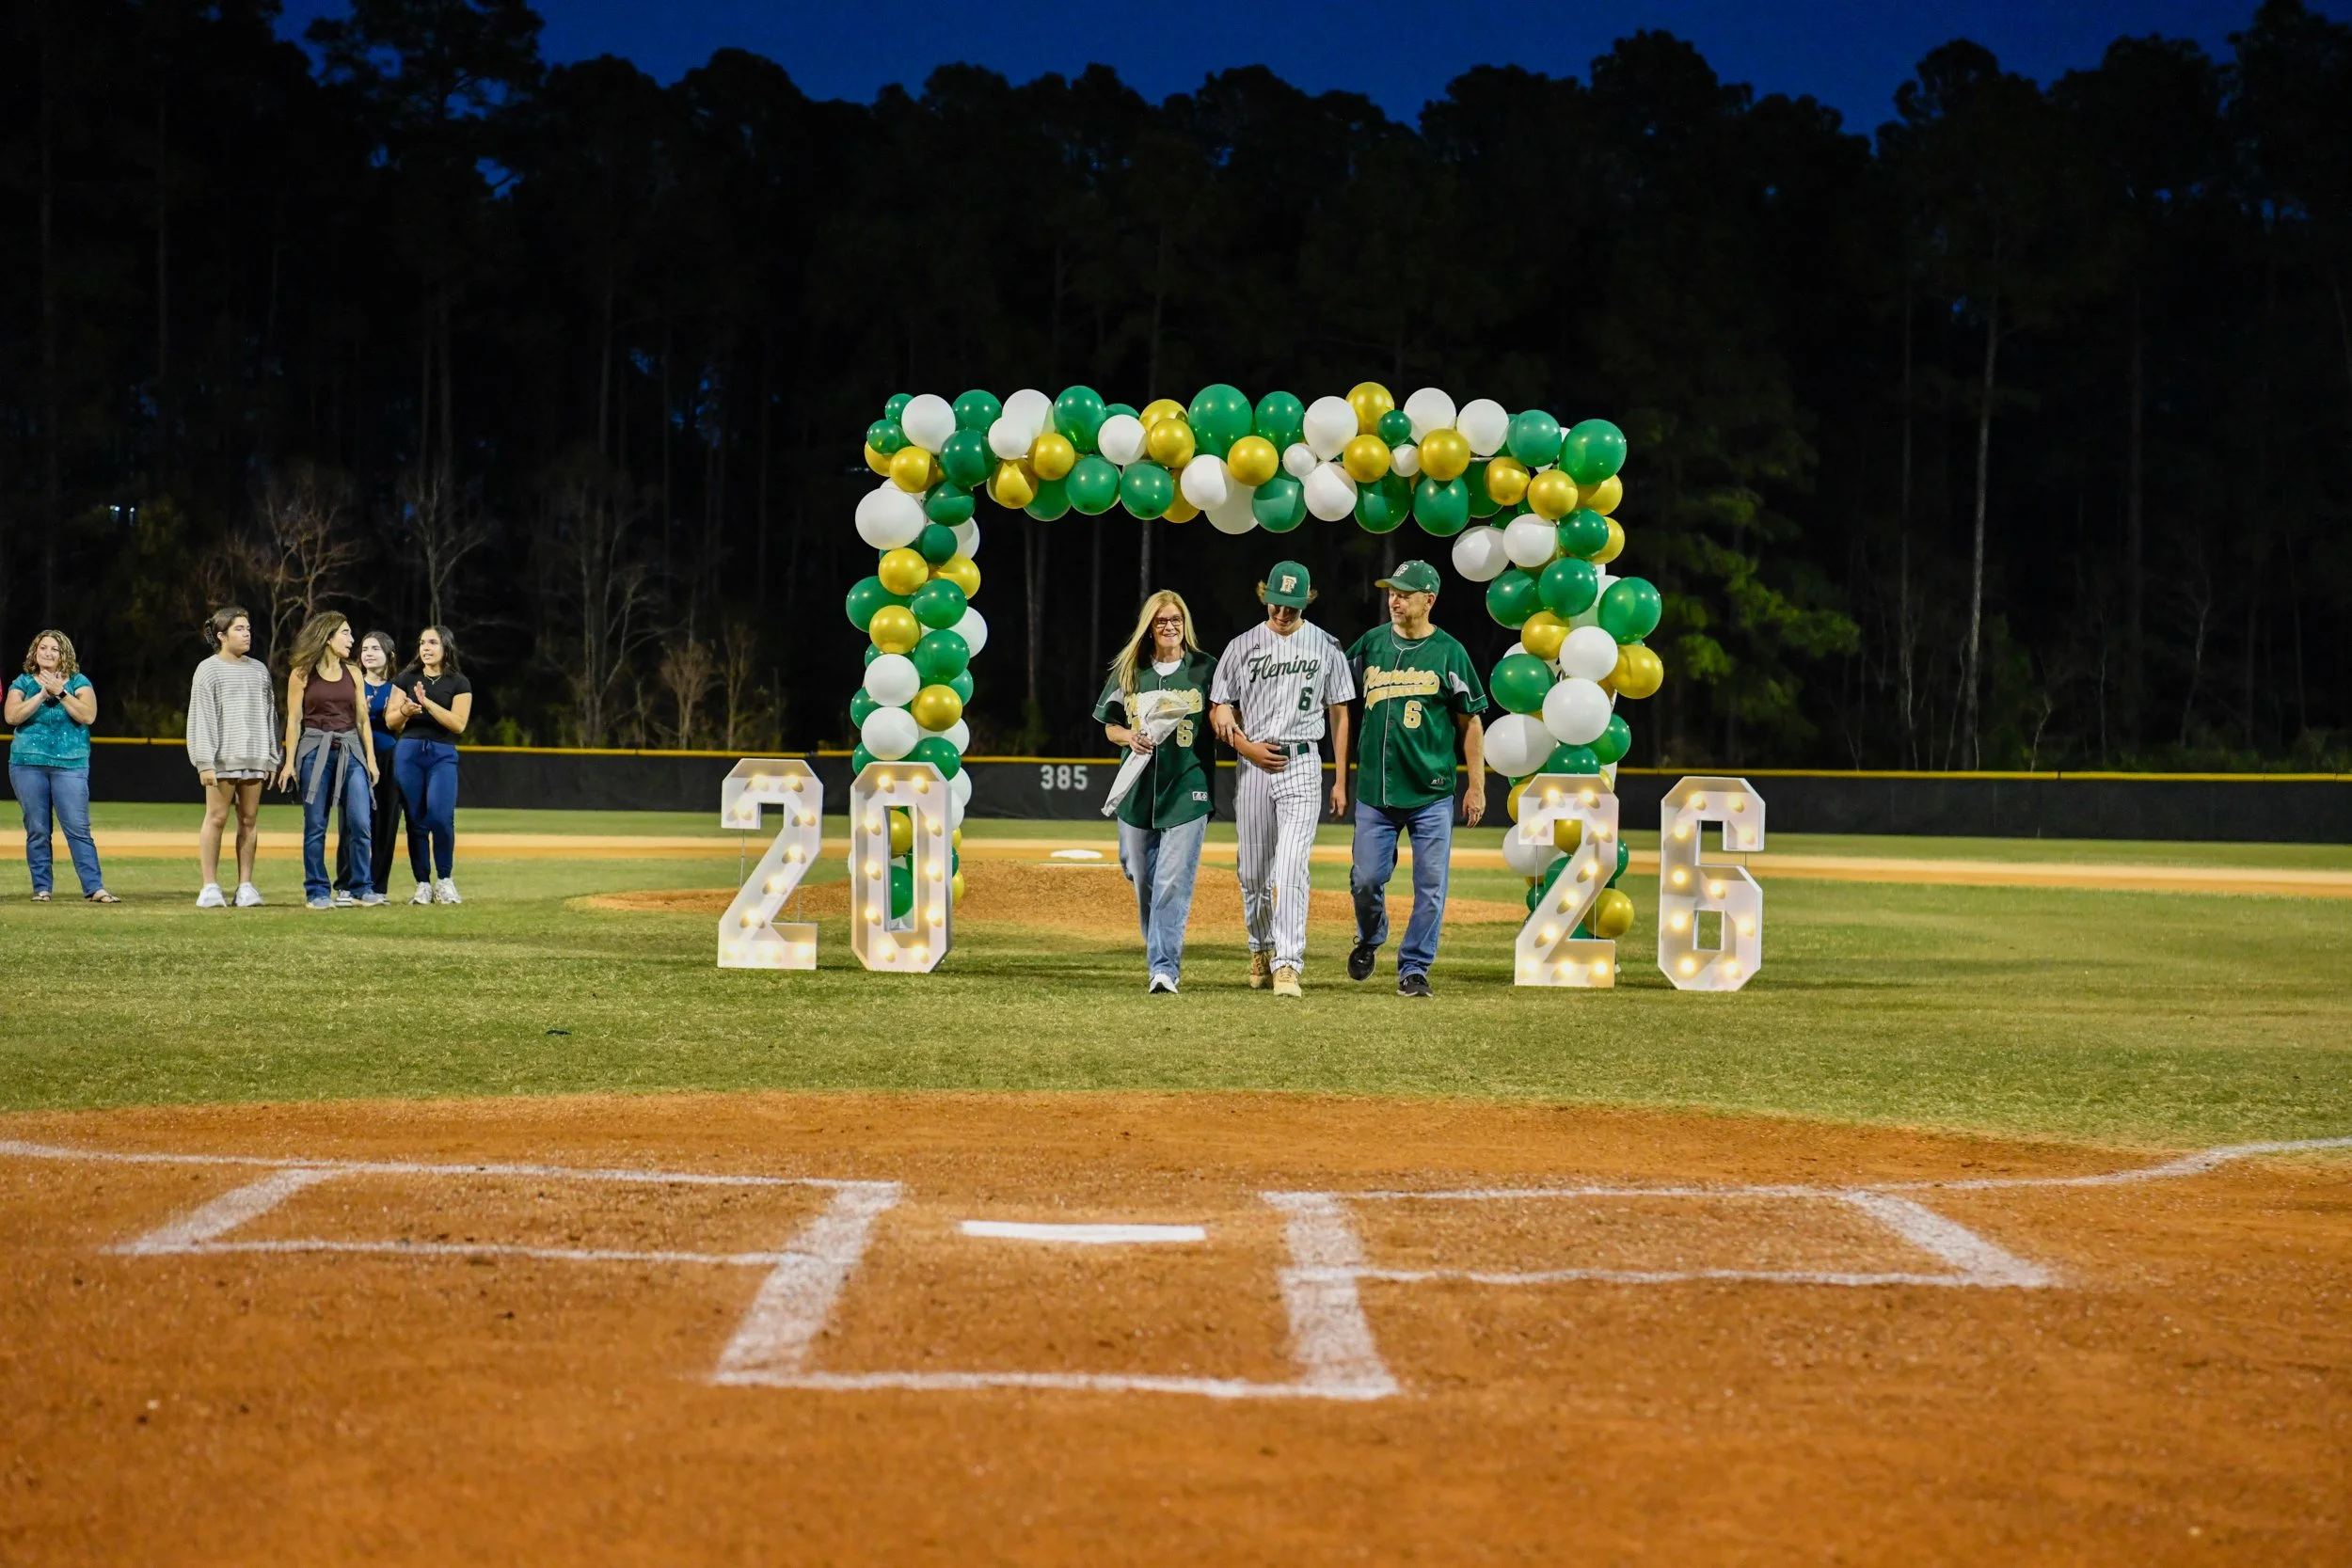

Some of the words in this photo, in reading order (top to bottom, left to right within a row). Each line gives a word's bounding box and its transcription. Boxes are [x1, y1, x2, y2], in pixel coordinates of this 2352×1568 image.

[1248, 654, 1321, 683] Fleming
[1298, 687, 1313, 711] 6
[1403, 700, 1422, 729] 6
[1176, 720, 1194, 747] 6
[1041, 765, 1089, 791] 385
